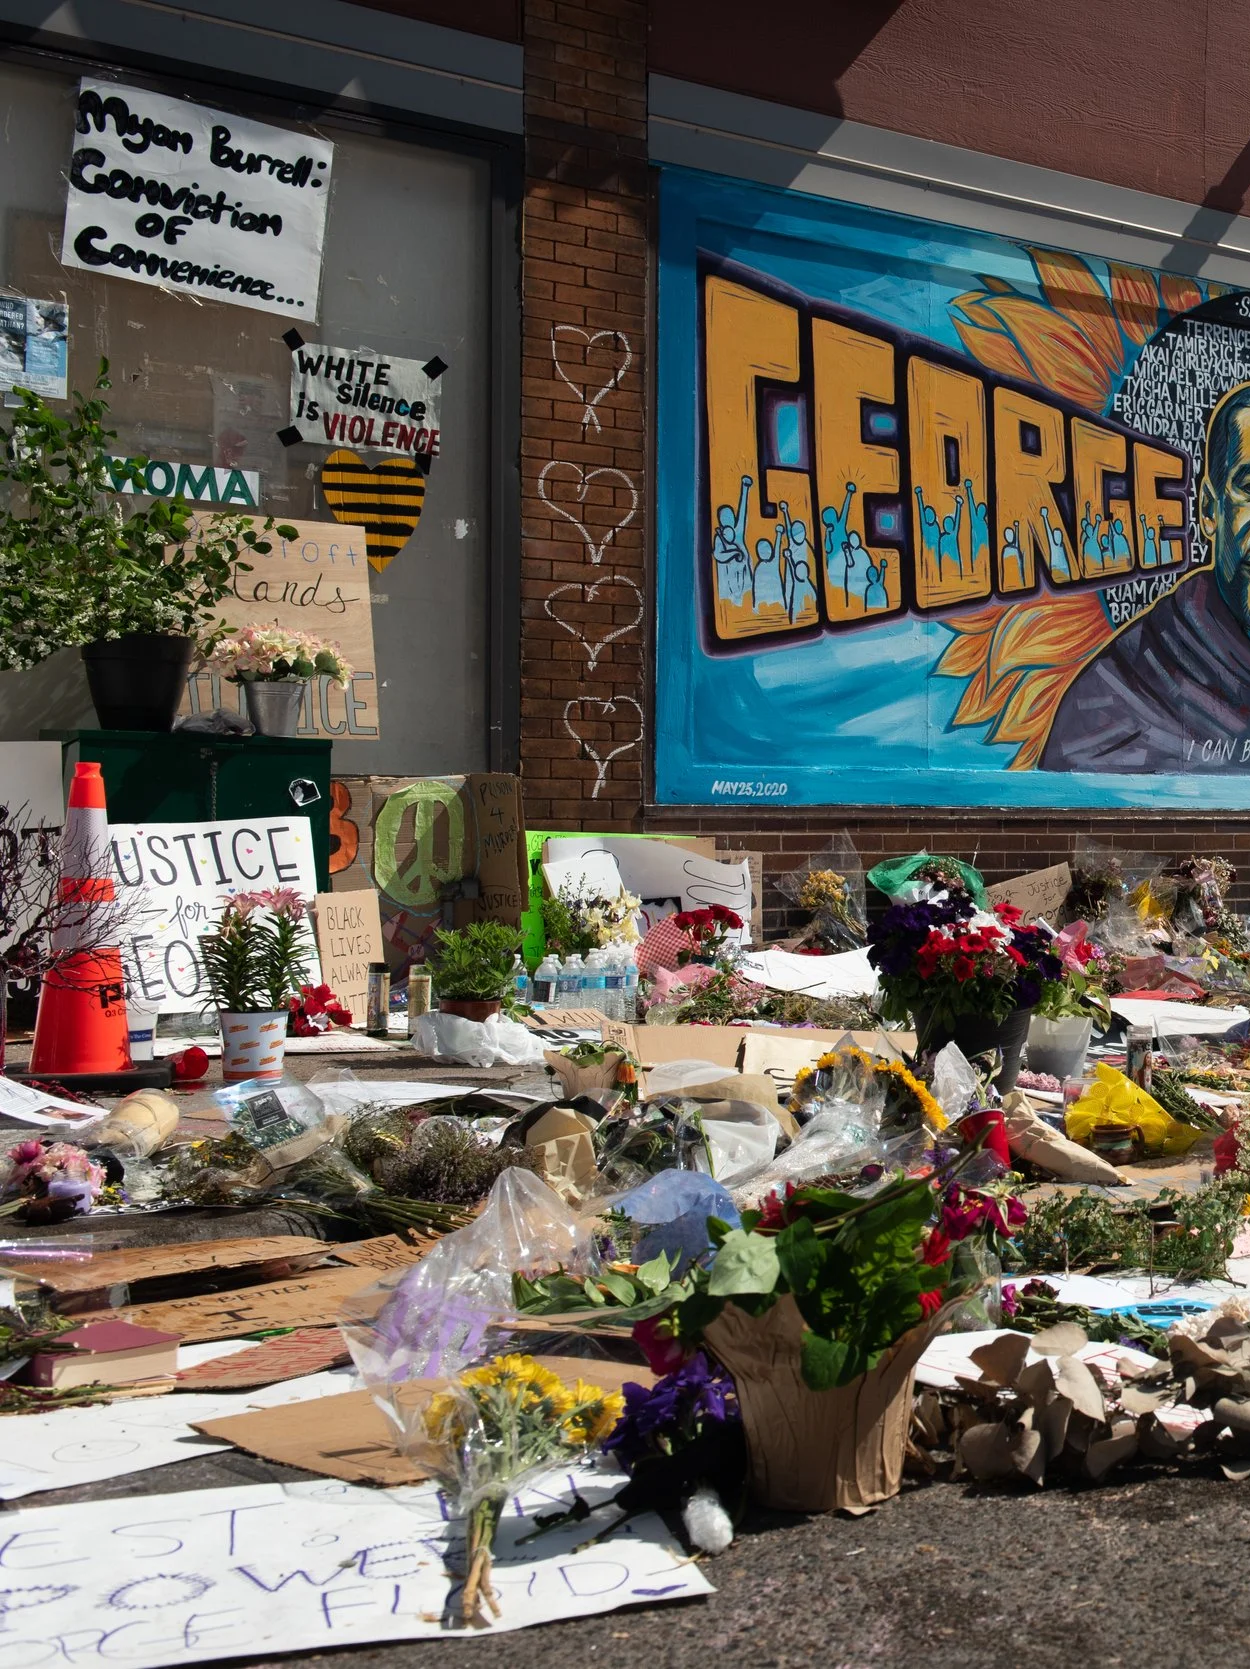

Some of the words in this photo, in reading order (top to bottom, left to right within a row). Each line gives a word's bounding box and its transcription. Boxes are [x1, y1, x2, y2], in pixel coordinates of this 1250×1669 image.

[71, 148, 282, 236] Conviction
[1165, 332, 1208, 359] TAMIR
[1209, 342, 1241, 363] RICE
[1183, 318, 1250, 350] TERRENCE
[298, 350, 391, 386] WHITE
[1134, 360, 1193, 386] MICHAEL
[1140, 344, 1169, 366] AKAI
[1172, 351, 1213, 373] GURLEY
[336, 382, 426, 421] Silence
[1124, 376, 1171, 401] TYISHA
[296, 392, 319, 421] is
[323, 411, 440, 457] VIOLENCE
[1113, 393, 1145, 415] ERIC
[1146, 399, 1205, 425] GARNER
[1124, 412, 1179, 439] SANDRA
[703, 272, 1186, 641] GEORGE
[231, 565, 360, 613] tands
[1200, 738, 1237, 762] CAN
[111, 827, 301, 887] USTICE
[1026, 876, 1068, 897] Justice
[1042, 893, 1056, 906] for
[169, 896, 209, 939] for
[327, 907, 364, 931] BLACK
[330, 934, 371, 958] LIVES
[331, 962, 370, 988] ALWAY
